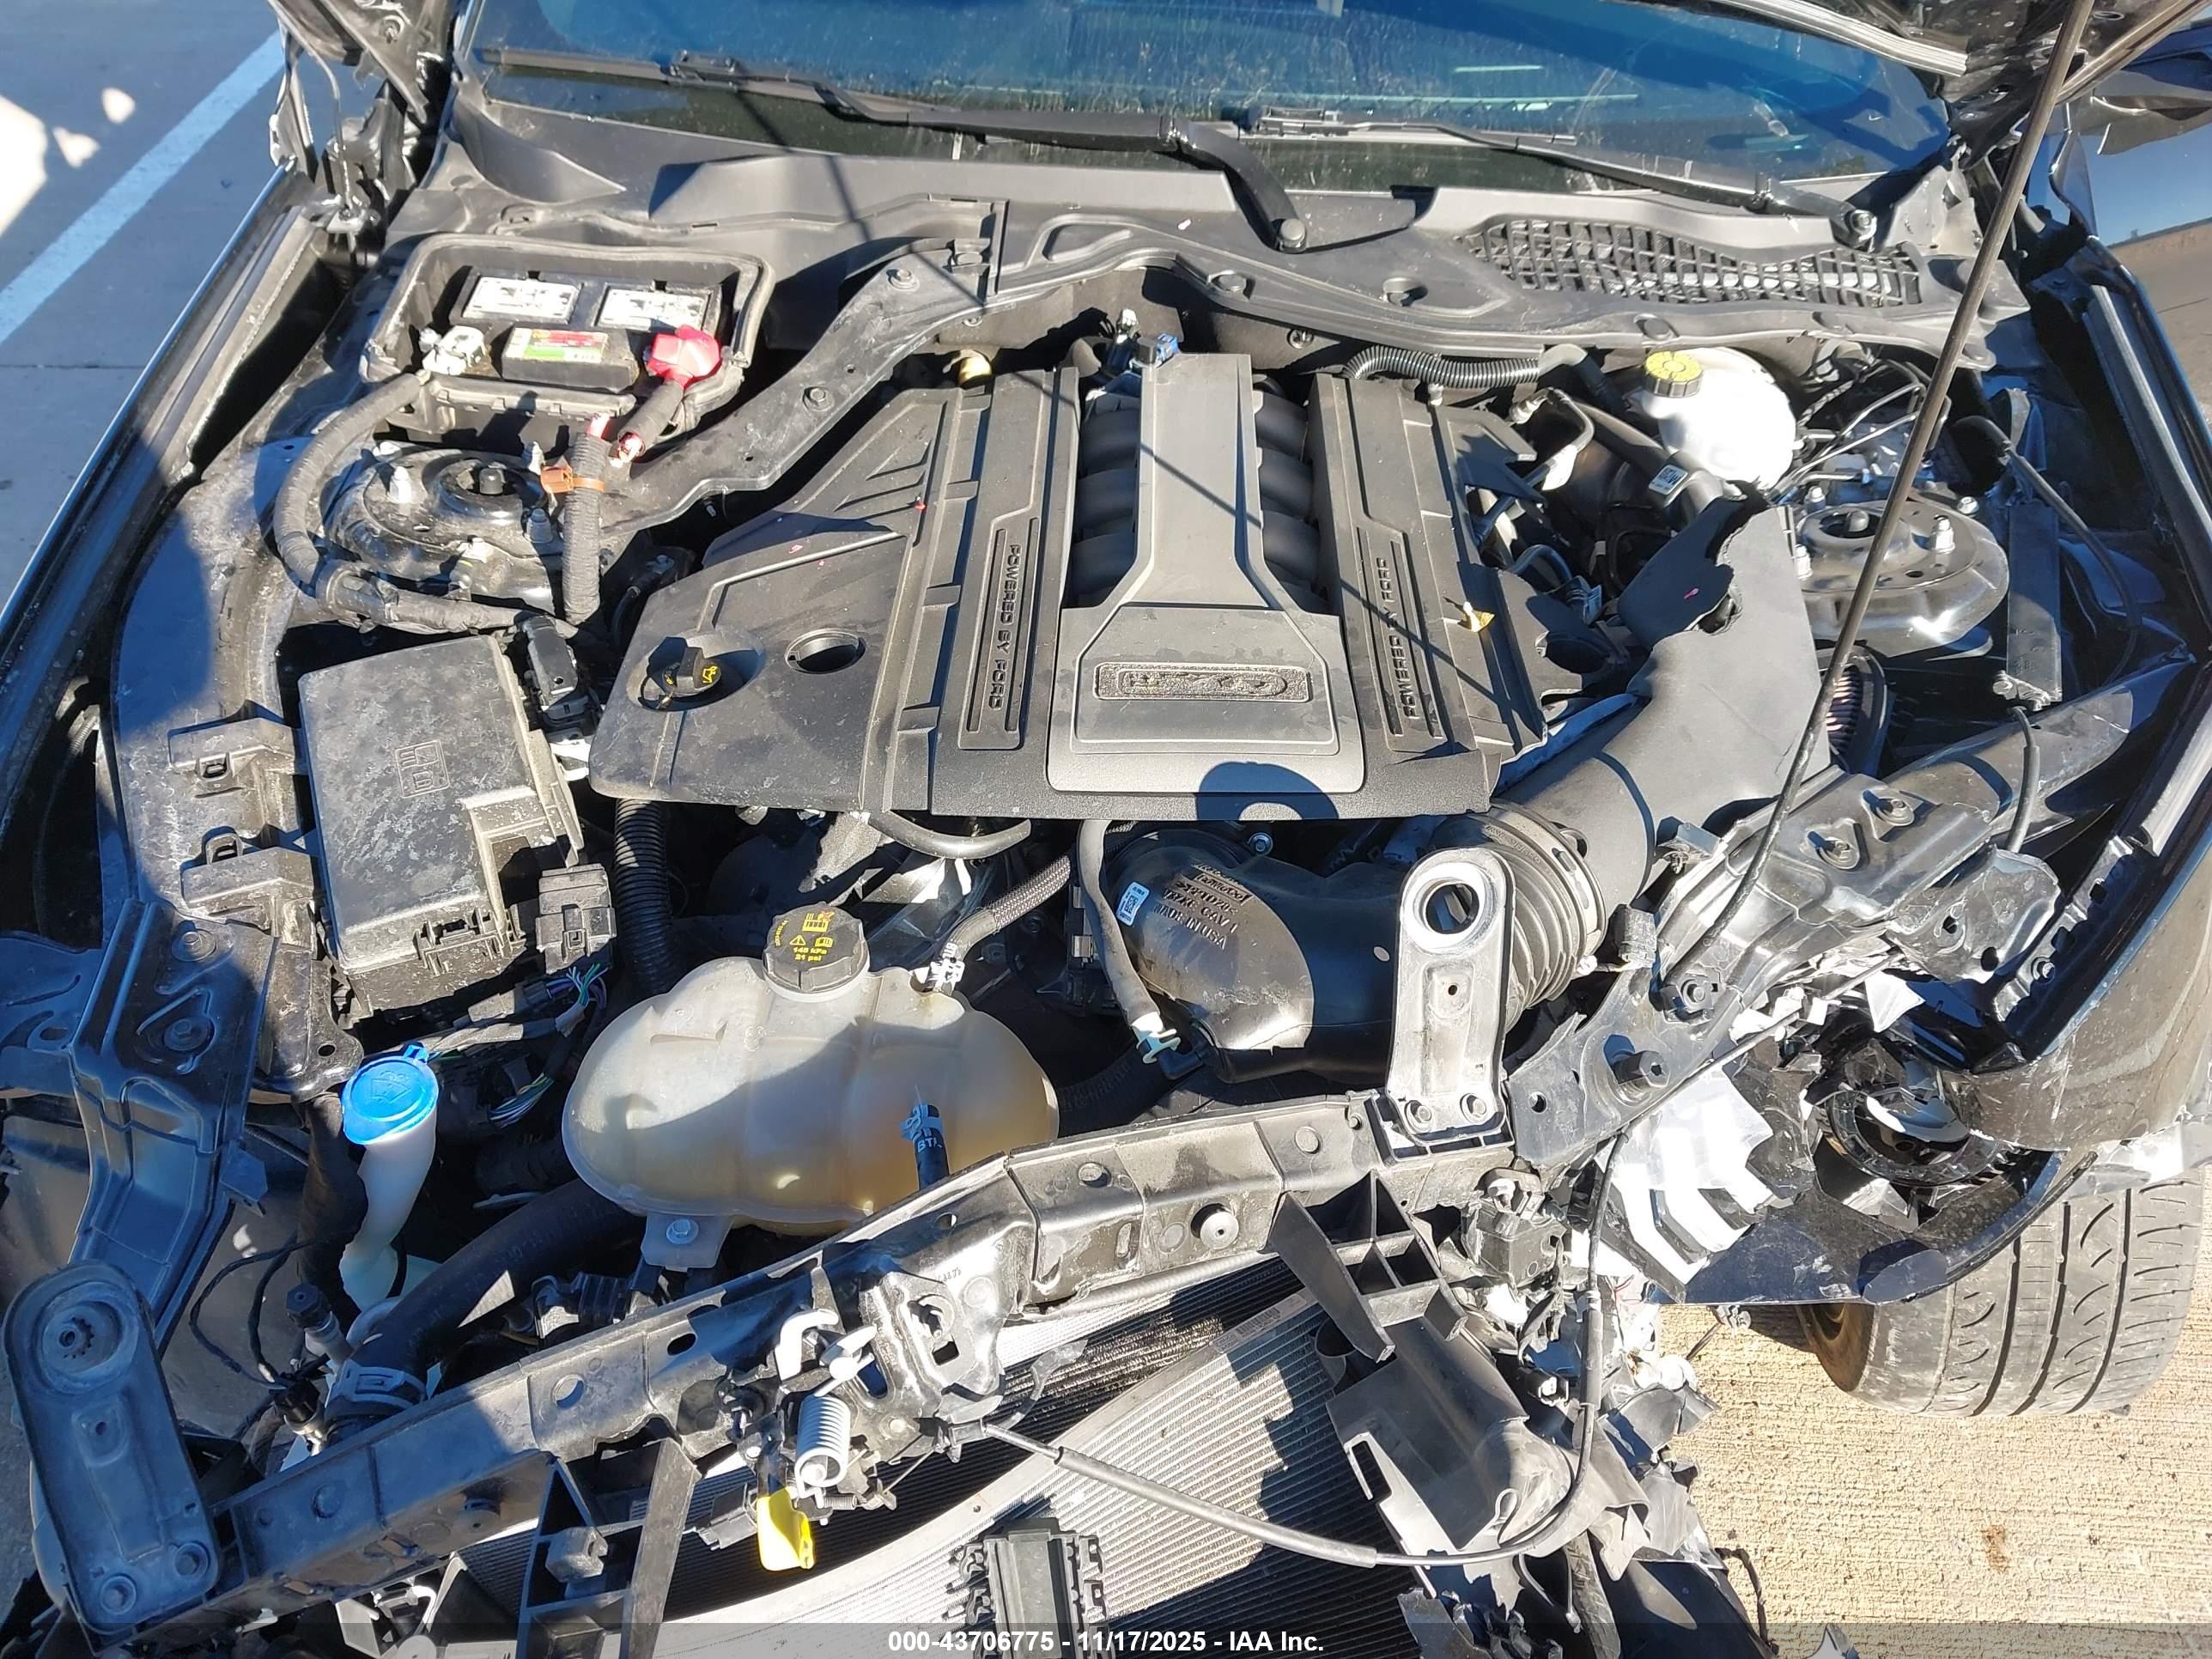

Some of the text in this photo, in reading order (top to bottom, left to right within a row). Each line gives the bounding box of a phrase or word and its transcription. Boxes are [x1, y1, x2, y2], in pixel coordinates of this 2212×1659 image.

[1376, 557, 1395, 602] FORD
[988, 544, 1021, 709] POWERED BY FORD
[1389, 635, 1419, 719] POWERED
[1153, 902, 1184, 925] MADE
[1186, 916, 1201, 932] IN
[1200, 925, 1226, 950] USA
